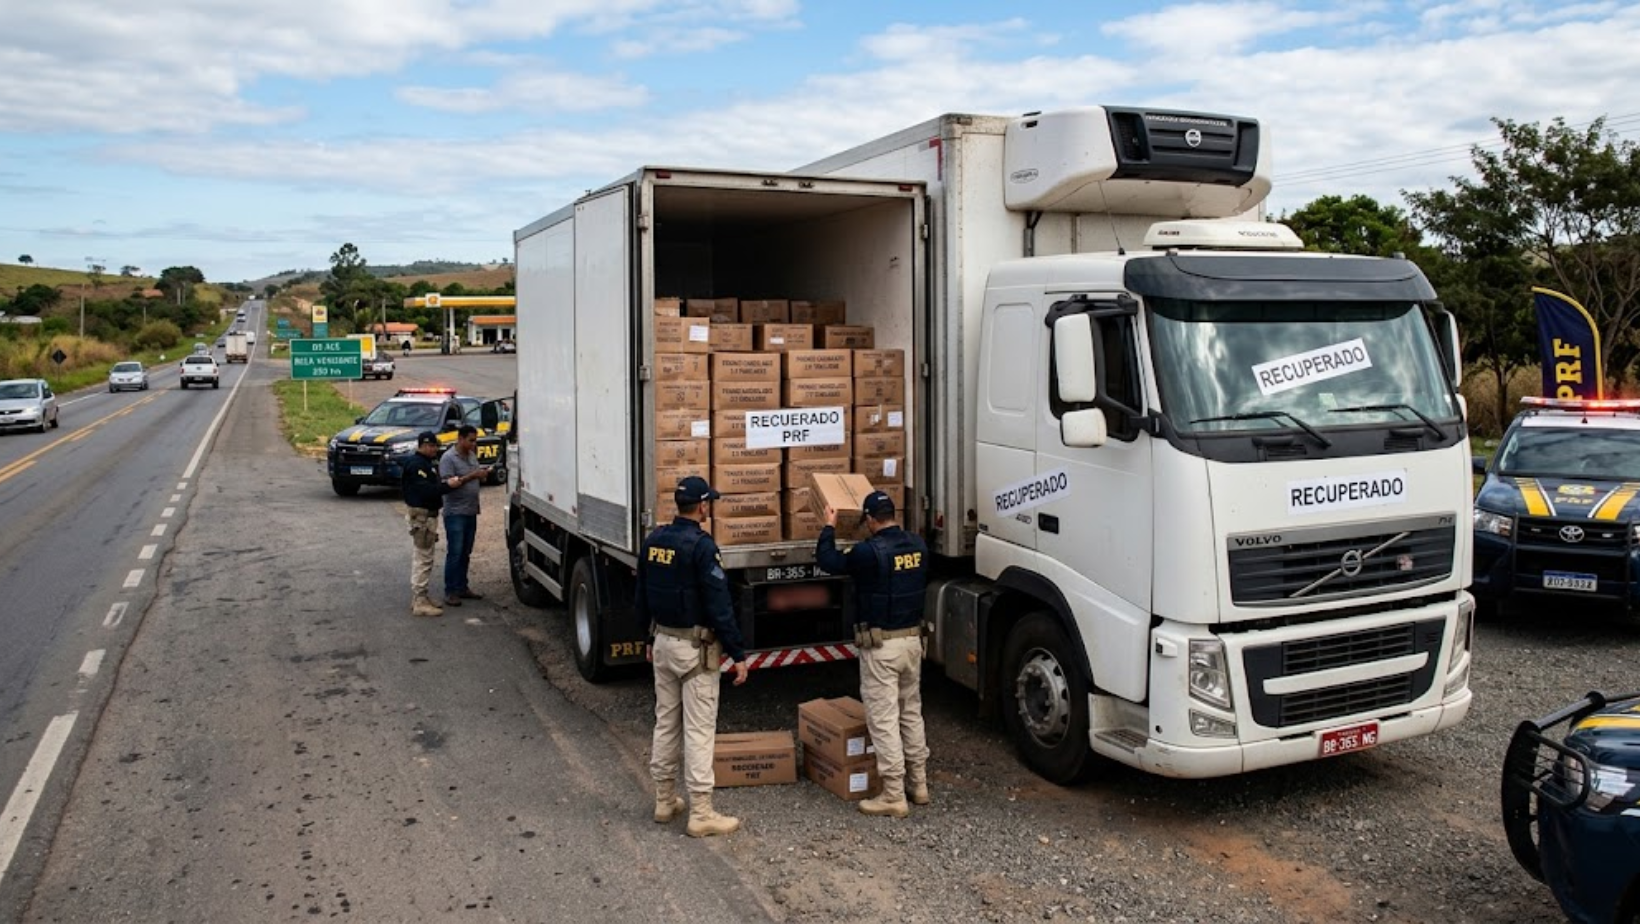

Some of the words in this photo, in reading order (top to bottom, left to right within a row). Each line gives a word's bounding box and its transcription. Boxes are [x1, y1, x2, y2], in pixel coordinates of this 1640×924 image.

[1259, 346, 1365, 388] RECUPERADO
[1552, 338, 1583, 402] PRF
[750, 411, 839, 428] RECUERADO
[782, 429, 810, 442] PRF
[995, 472, 1067, 511] RECUPERADO
[1291, 477, 1404, 507] RECUPERADO
[1235, 535, 1282, 547] VOLVO
[767, 568, 805, 580] BR-365
[610, 641, 645, 657] PRF
